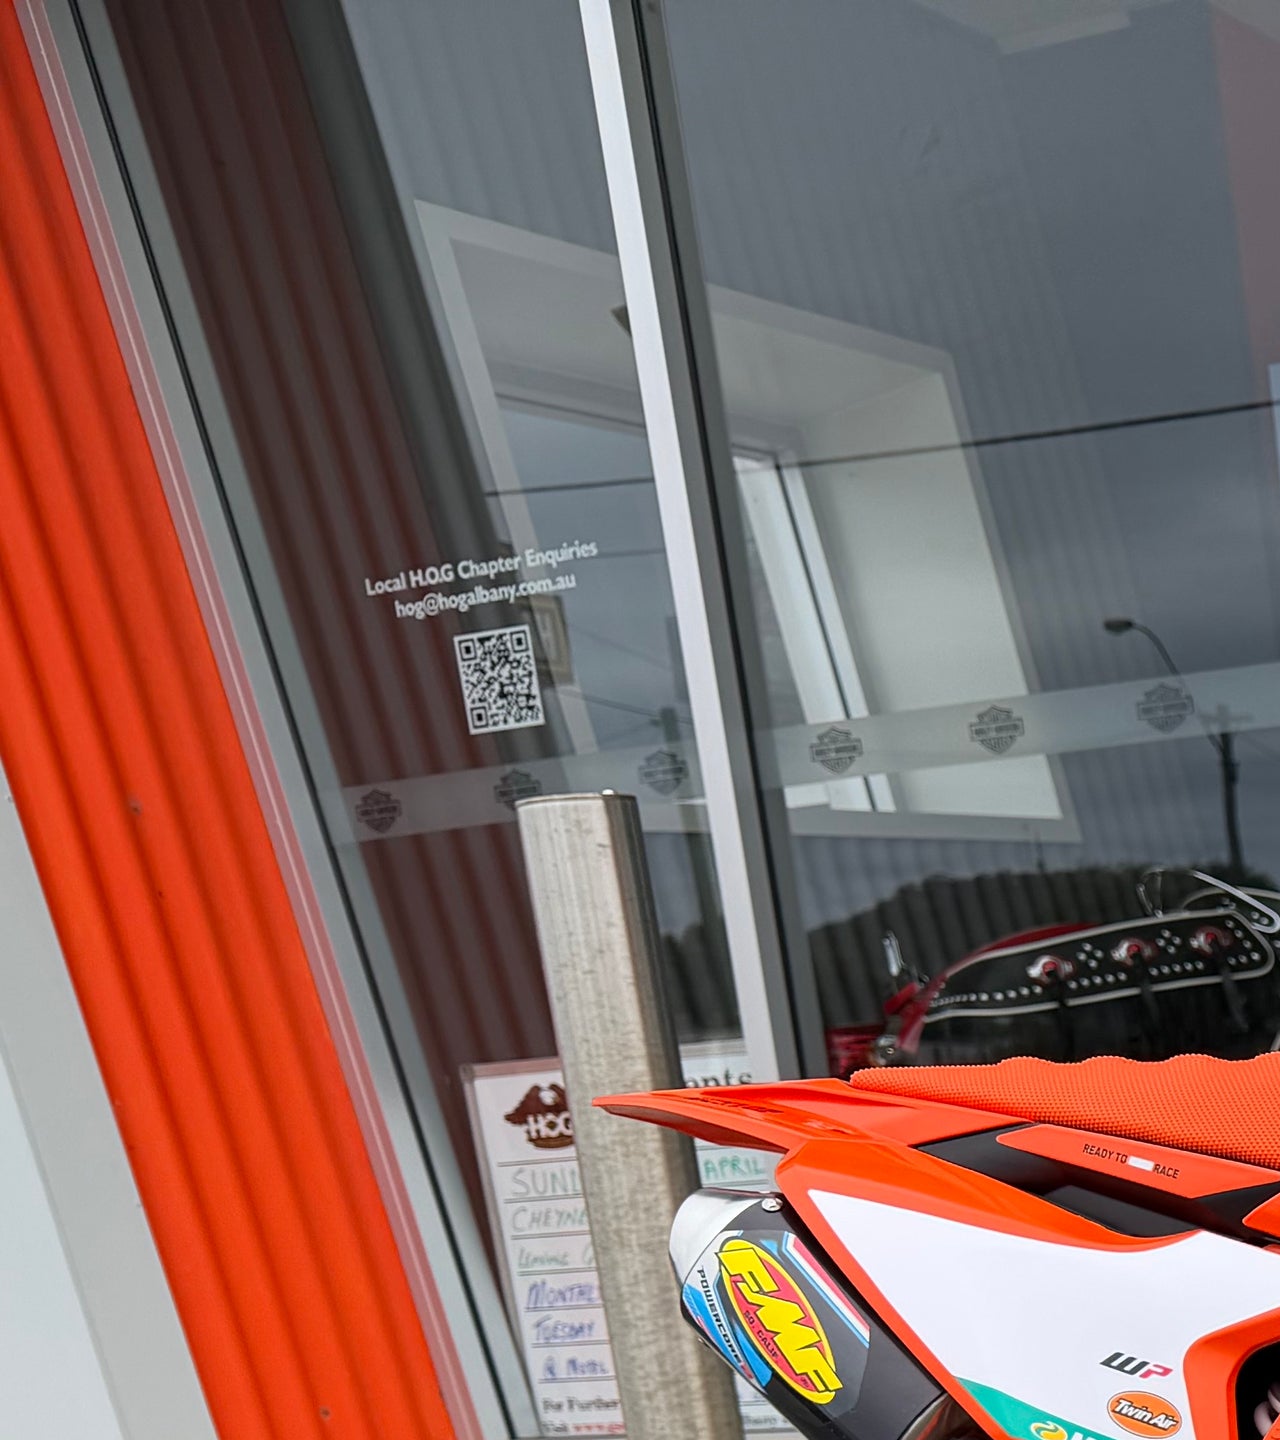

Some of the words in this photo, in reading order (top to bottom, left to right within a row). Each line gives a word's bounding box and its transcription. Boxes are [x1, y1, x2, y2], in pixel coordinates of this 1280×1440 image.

[364, 572, 406, 596] Local
[409, 564, 455, 588] H.O.G
[457, 554, 522, 579] Chapter
[525, 540, 599, 568] Enquiries
[394, 572, 577, 620] hog@hogalbany.com.au
[703, 1155, 766, 1180] APRIL
[1082, 1143, 1114, 1161] READY
[1115, 1152, 1128, 1165] TO
[1153, 1163, 1180, 1179] RACE
[696, 1266, 742, 1364] POWERCORE
[714, 1247, 843, 1393] FMF
[1099, 1352, 1173, 1379] WP
[1112, 1398, 1153, 1425] Twin
[1149, 1412, 1179, 1431] Air
